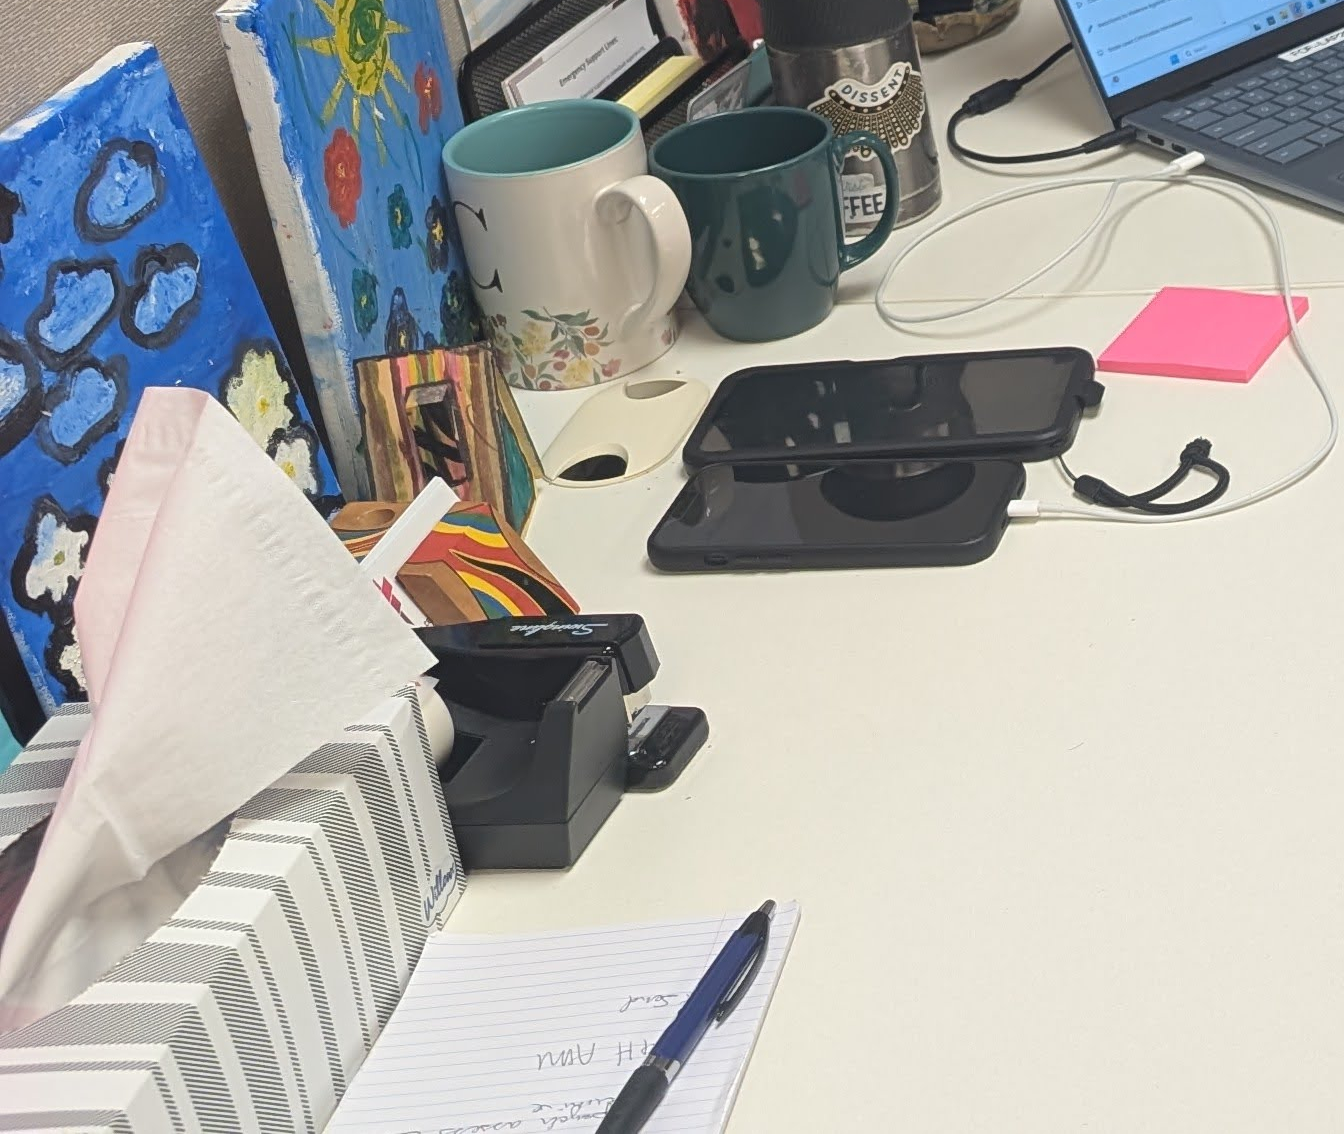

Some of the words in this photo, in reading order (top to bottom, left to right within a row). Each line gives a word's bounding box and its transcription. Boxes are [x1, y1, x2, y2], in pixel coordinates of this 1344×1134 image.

[559, 61, 587, 88] Emergency
[585, 46, 606, 68] Support
[841, 69, 903, 103] DISSENT
[843, 193, 886, 219] FFEE
[510, 621, 609, 637] Swingline
